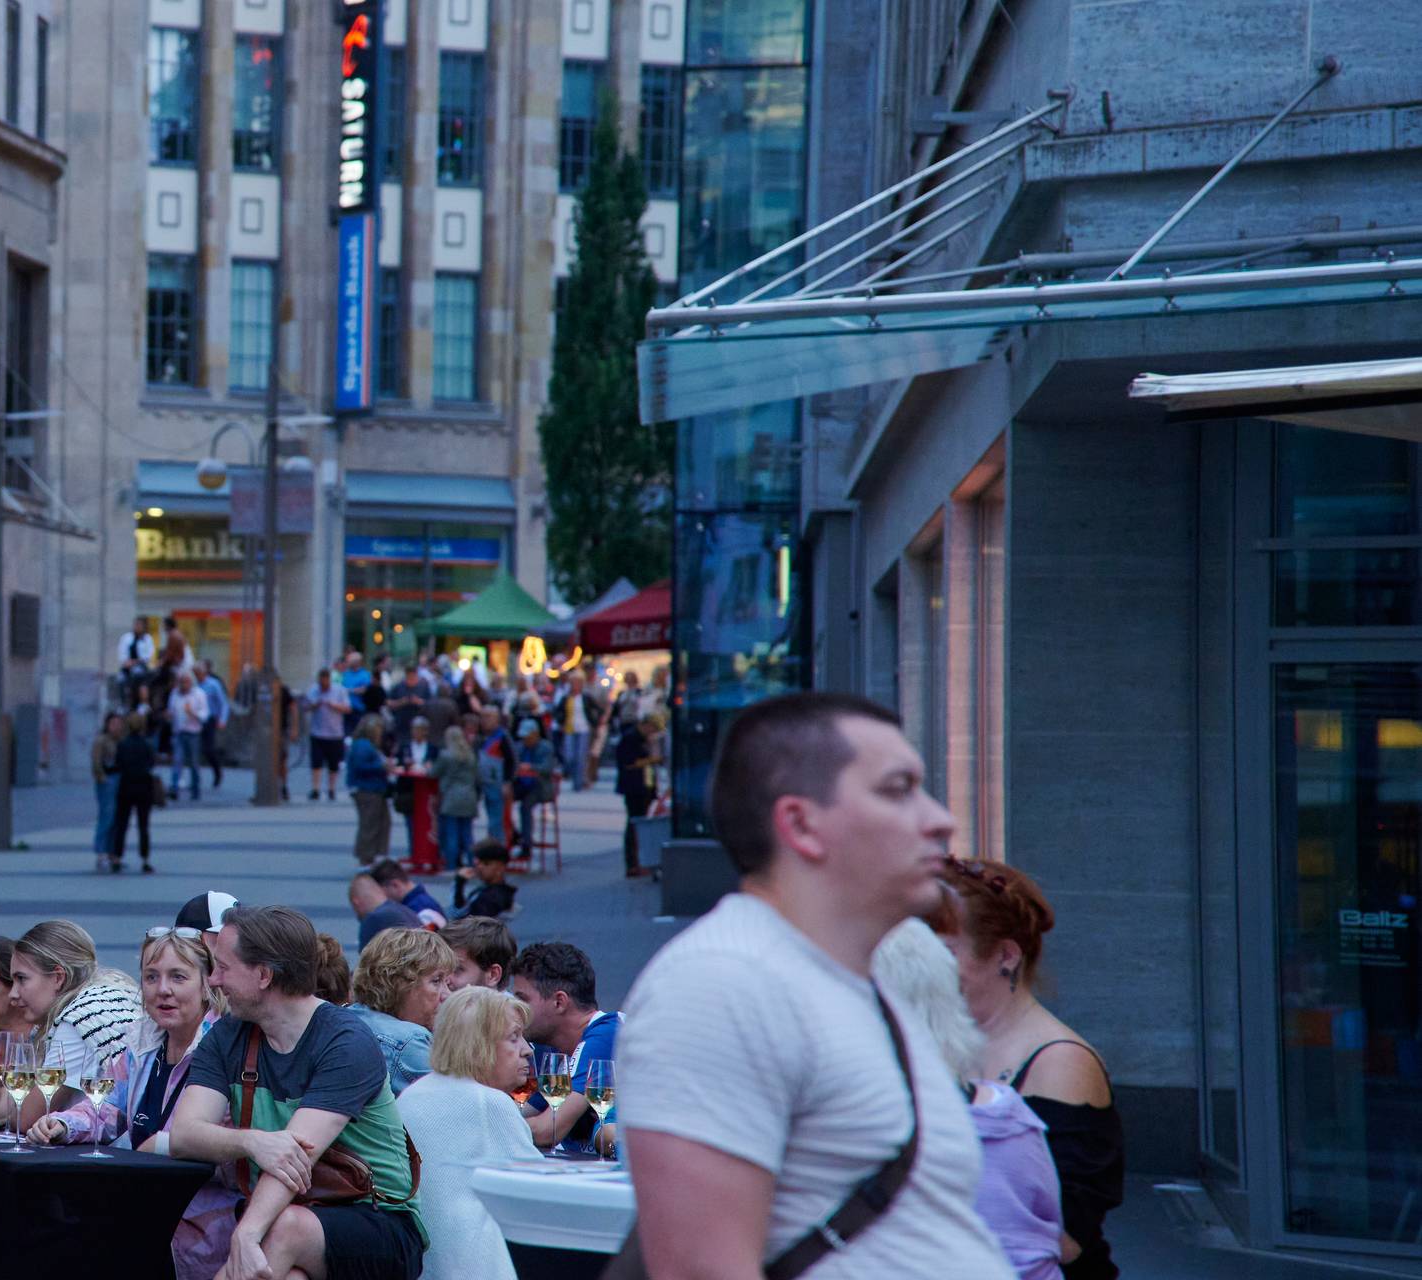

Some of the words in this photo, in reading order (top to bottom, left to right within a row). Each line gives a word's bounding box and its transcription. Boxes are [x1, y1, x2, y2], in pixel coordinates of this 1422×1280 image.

[339, 77, 366, 208] SATURN
[134, 528, 244, 561] Bank
[1339, 909, 1409, 928] Baltz
